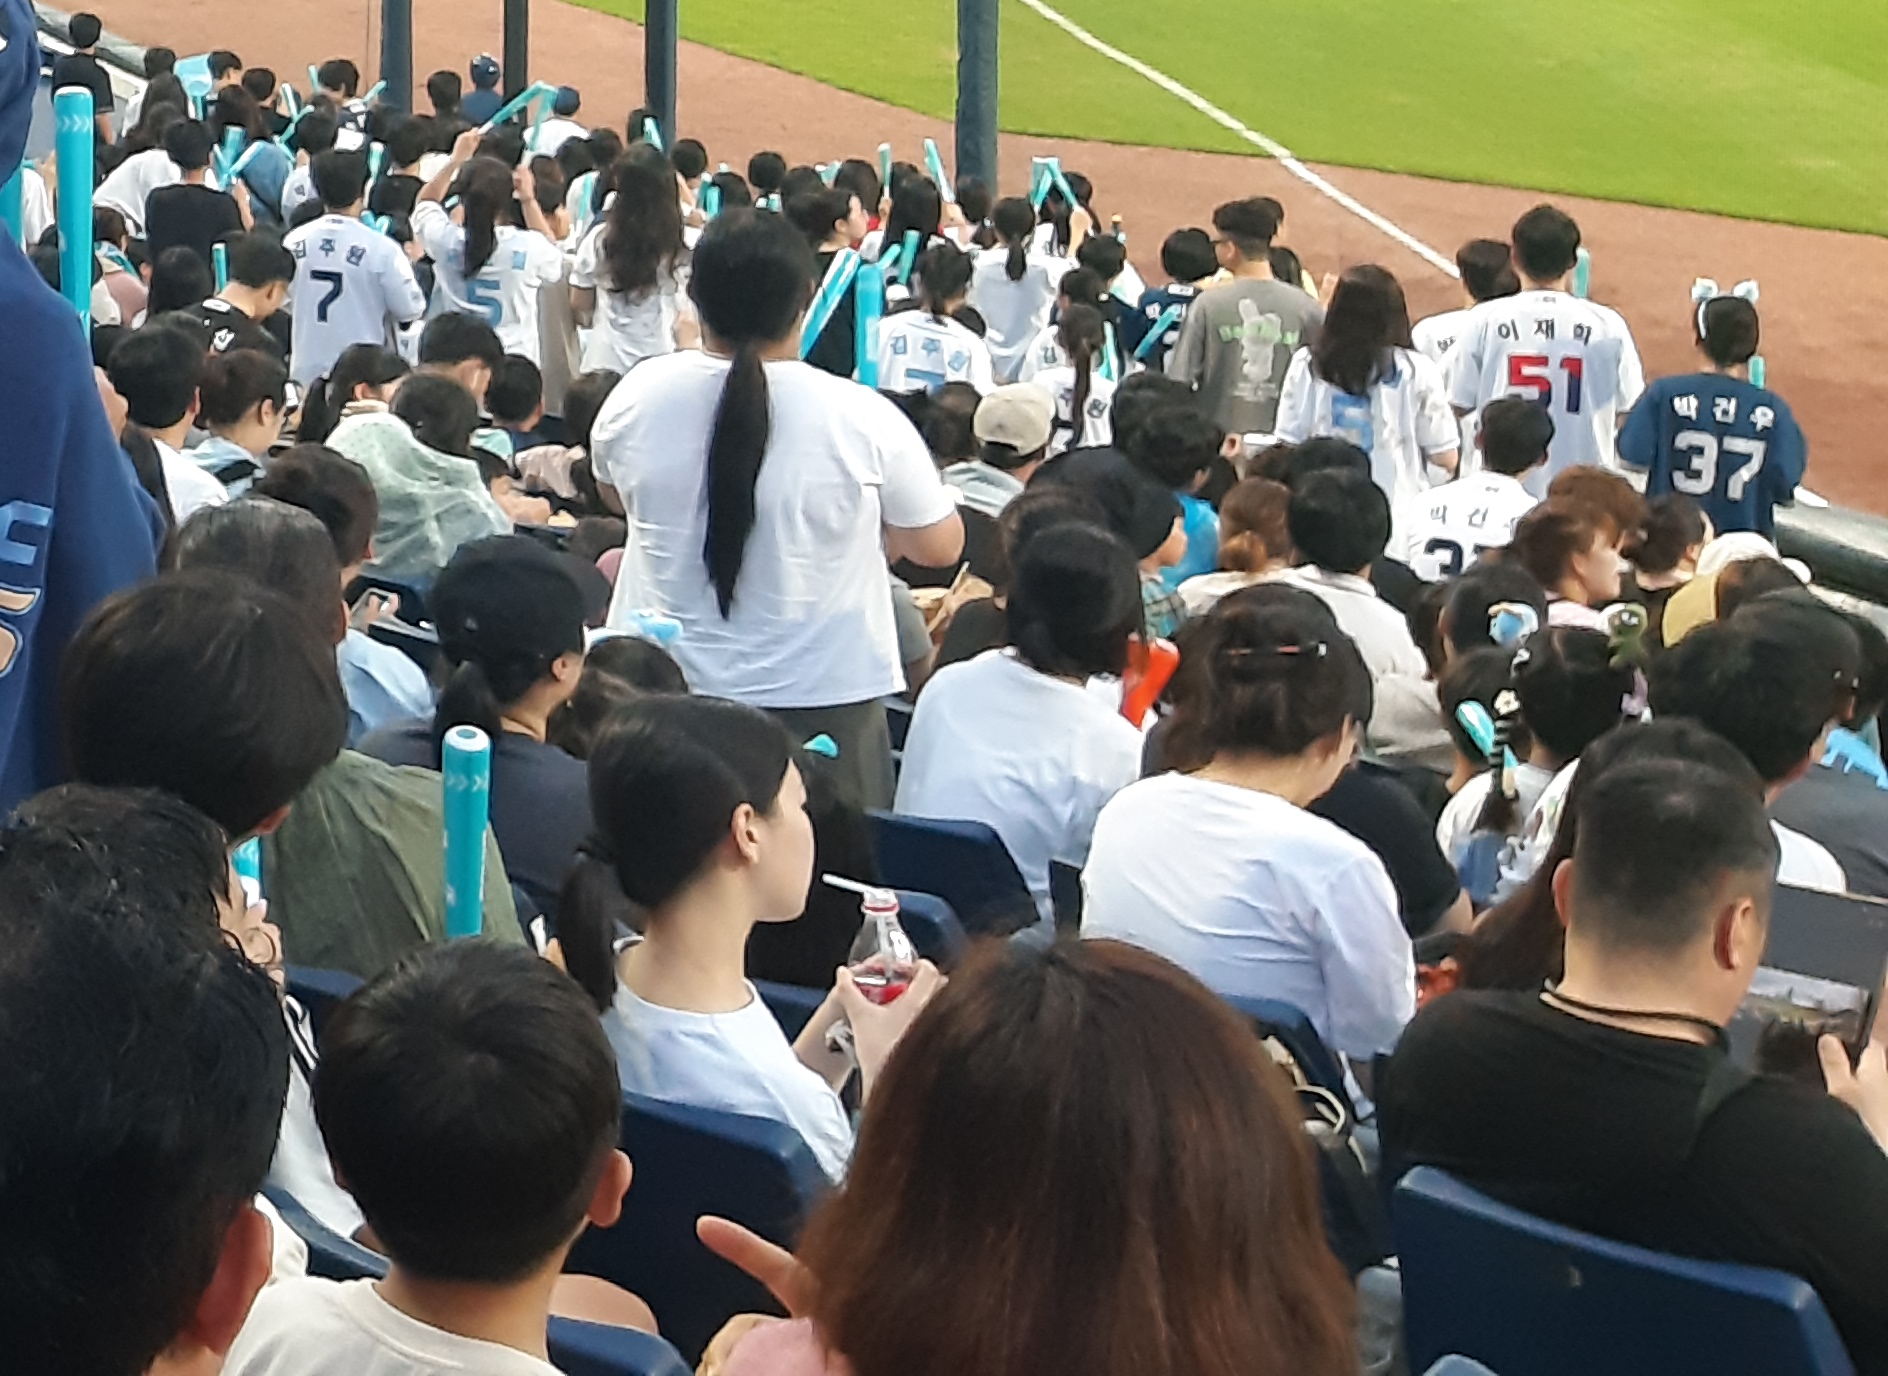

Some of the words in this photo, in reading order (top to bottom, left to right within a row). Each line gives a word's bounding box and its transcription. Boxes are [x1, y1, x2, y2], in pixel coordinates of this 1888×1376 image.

[310, 270, 344, 323] 7
[467, 280, 503, 327] 5
[1508, 355, 1584, 414] 51
[1672, 394, 1776, 431] 박건우
[1672, 431, 1767, 502] 37
